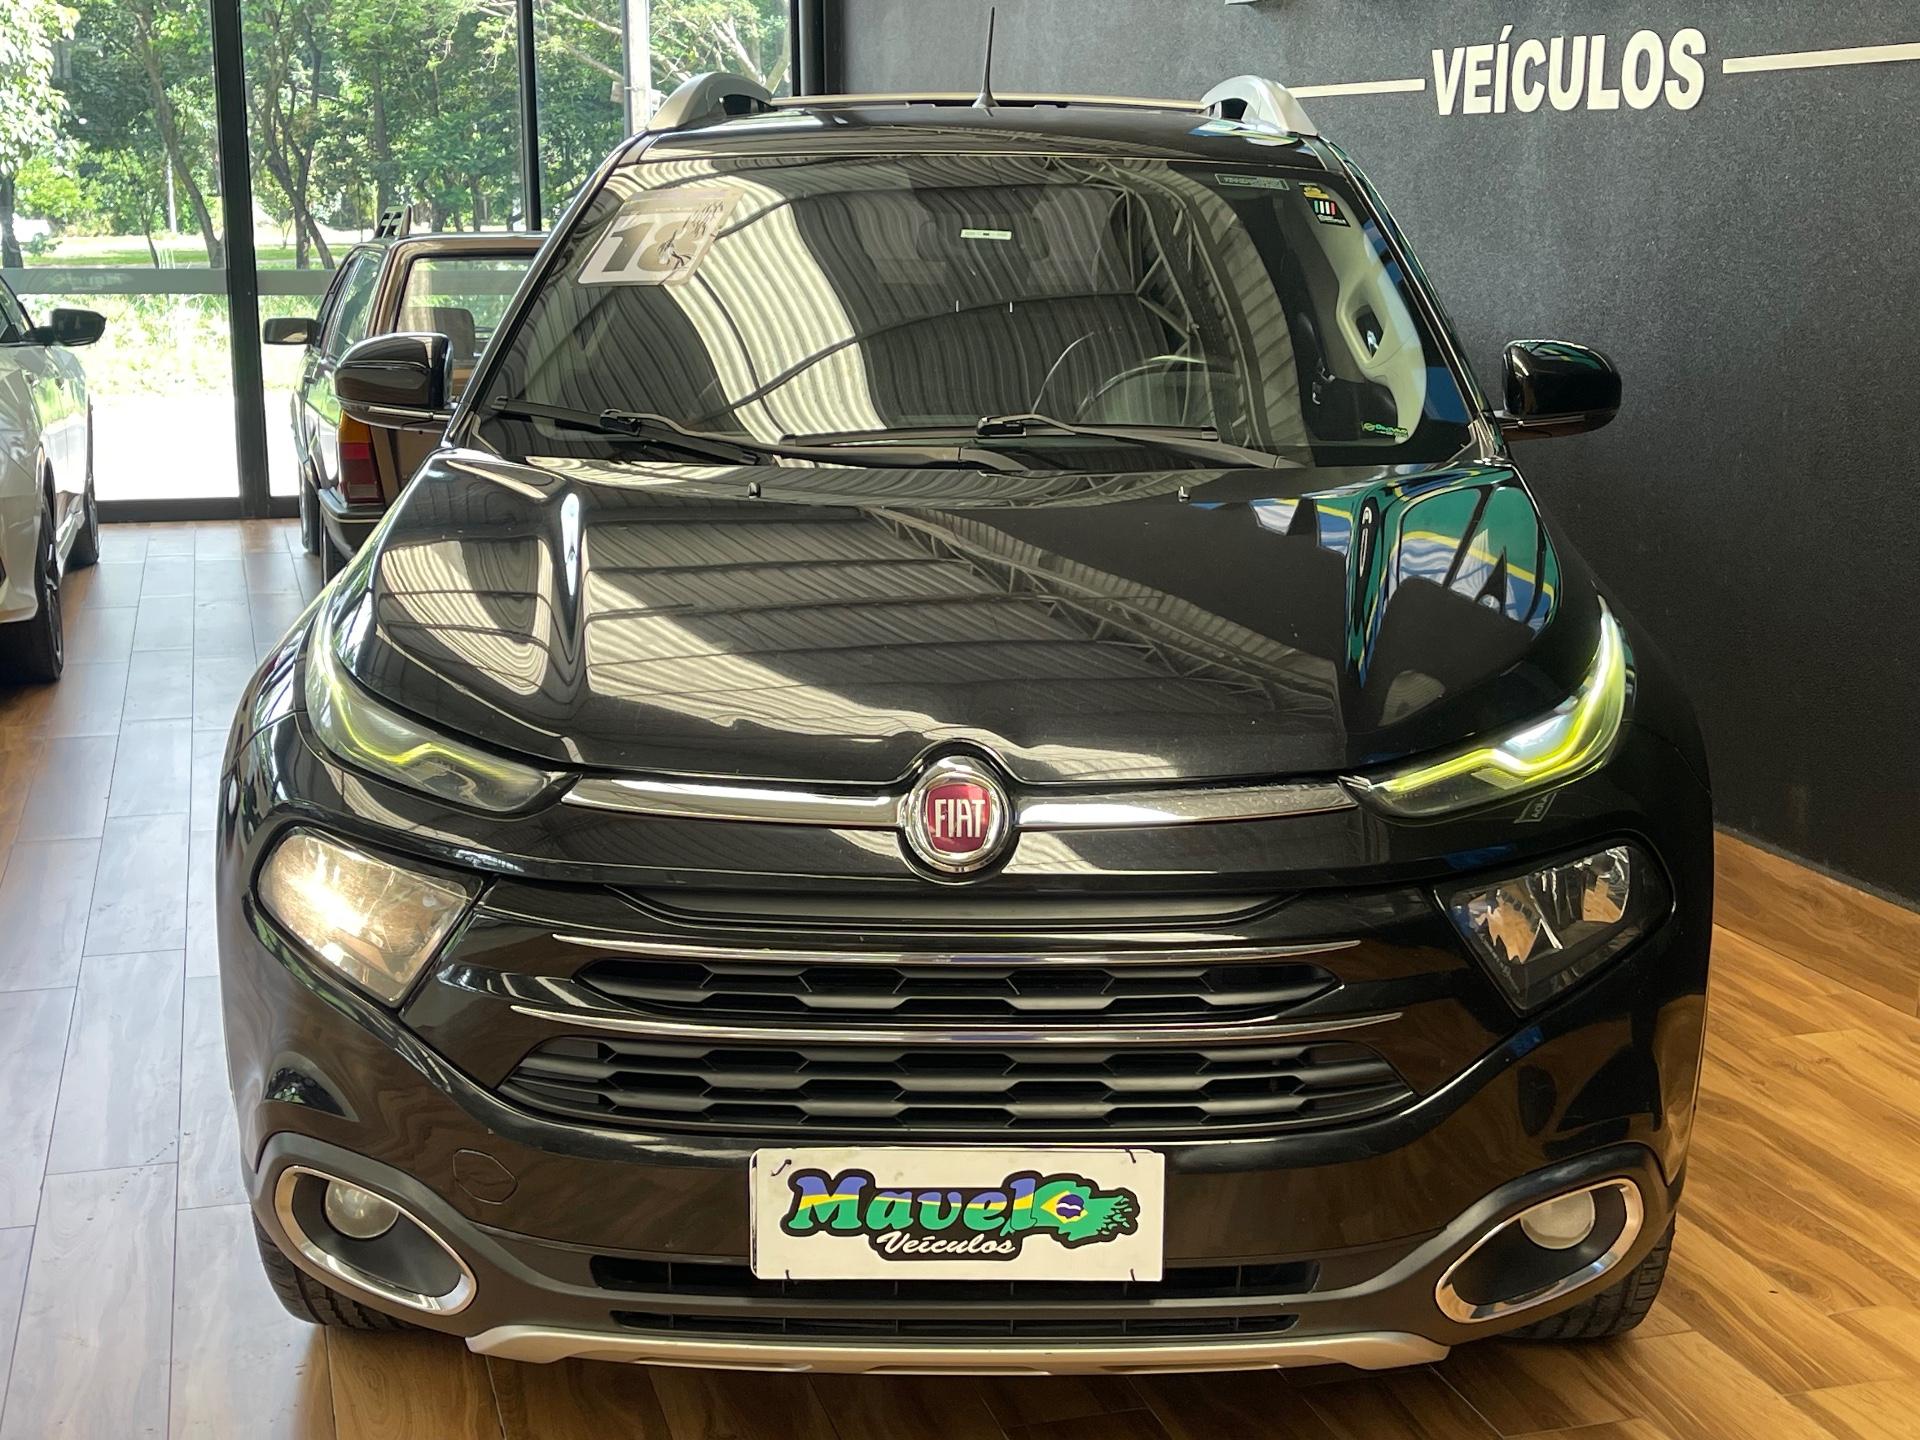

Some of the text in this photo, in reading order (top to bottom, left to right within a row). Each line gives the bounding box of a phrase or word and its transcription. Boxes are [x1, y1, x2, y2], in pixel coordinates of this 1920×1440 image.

[1431, 24, 1707, 116] VEÍCULOS
[934, 798, 986, 838] FIAT
[787, 1175, 1037, 1231] Mavel
[876, 1231, 1016, 1254] Veículos
